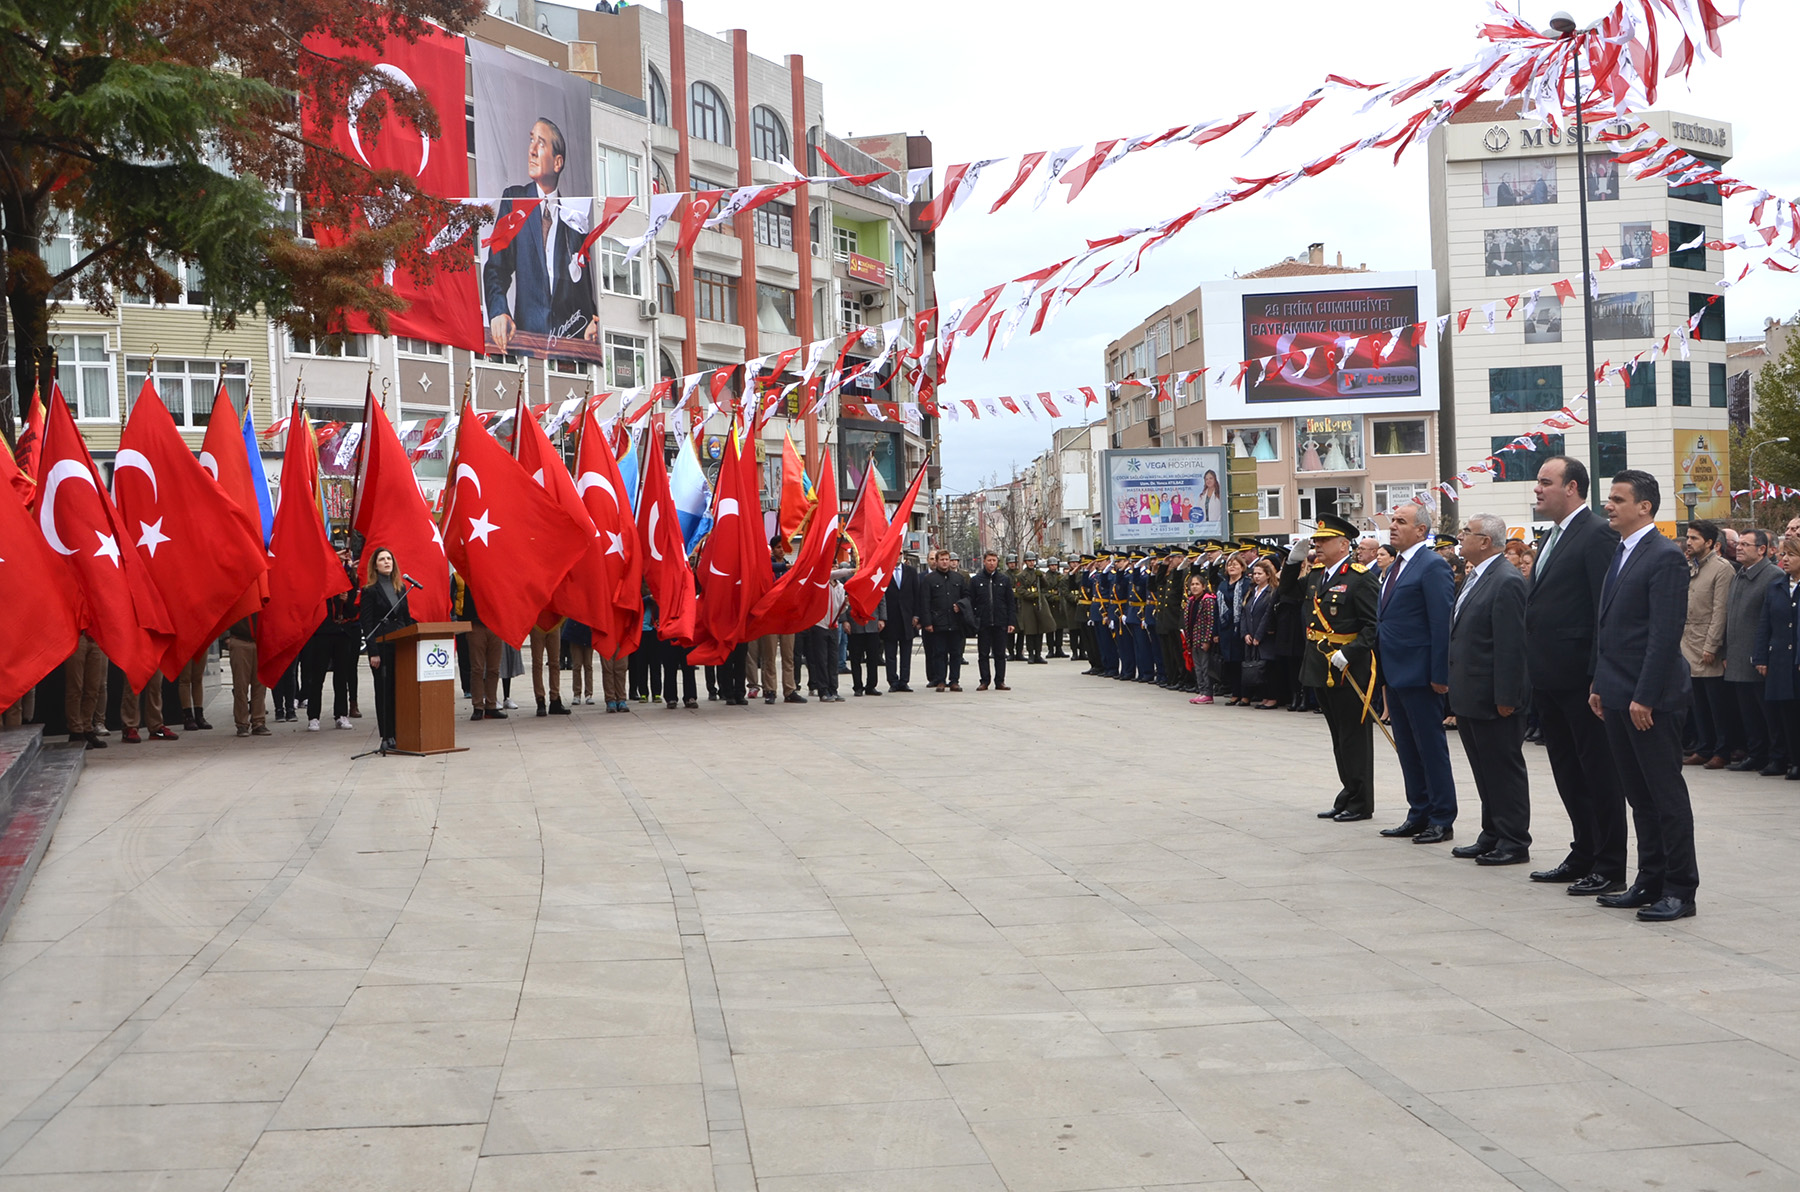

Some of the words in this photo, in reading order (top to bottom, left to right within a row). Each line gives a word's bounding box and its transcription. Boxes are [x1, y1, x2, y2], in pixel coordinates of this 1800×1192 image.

[1672, 120, 1727, 148] TEKİRDAĞ
[1264, 303, 1280, 317] 29
[1283, 299, 1312, 316] EKİM
[1316, 296, 1393, 314] CUMHURİYET
[1251, 319, 1327, 336] BAYRAMIMIZ
[1329, 318, 1367, 333] KUTLU
[1370, 316, 1409, 331] OLSUN
[1367, 373, 1415, 385] Provizyon
[1145, 462, 1166, 470] VEGA
[1168, 461, 1204, 469] HOSPITAL
